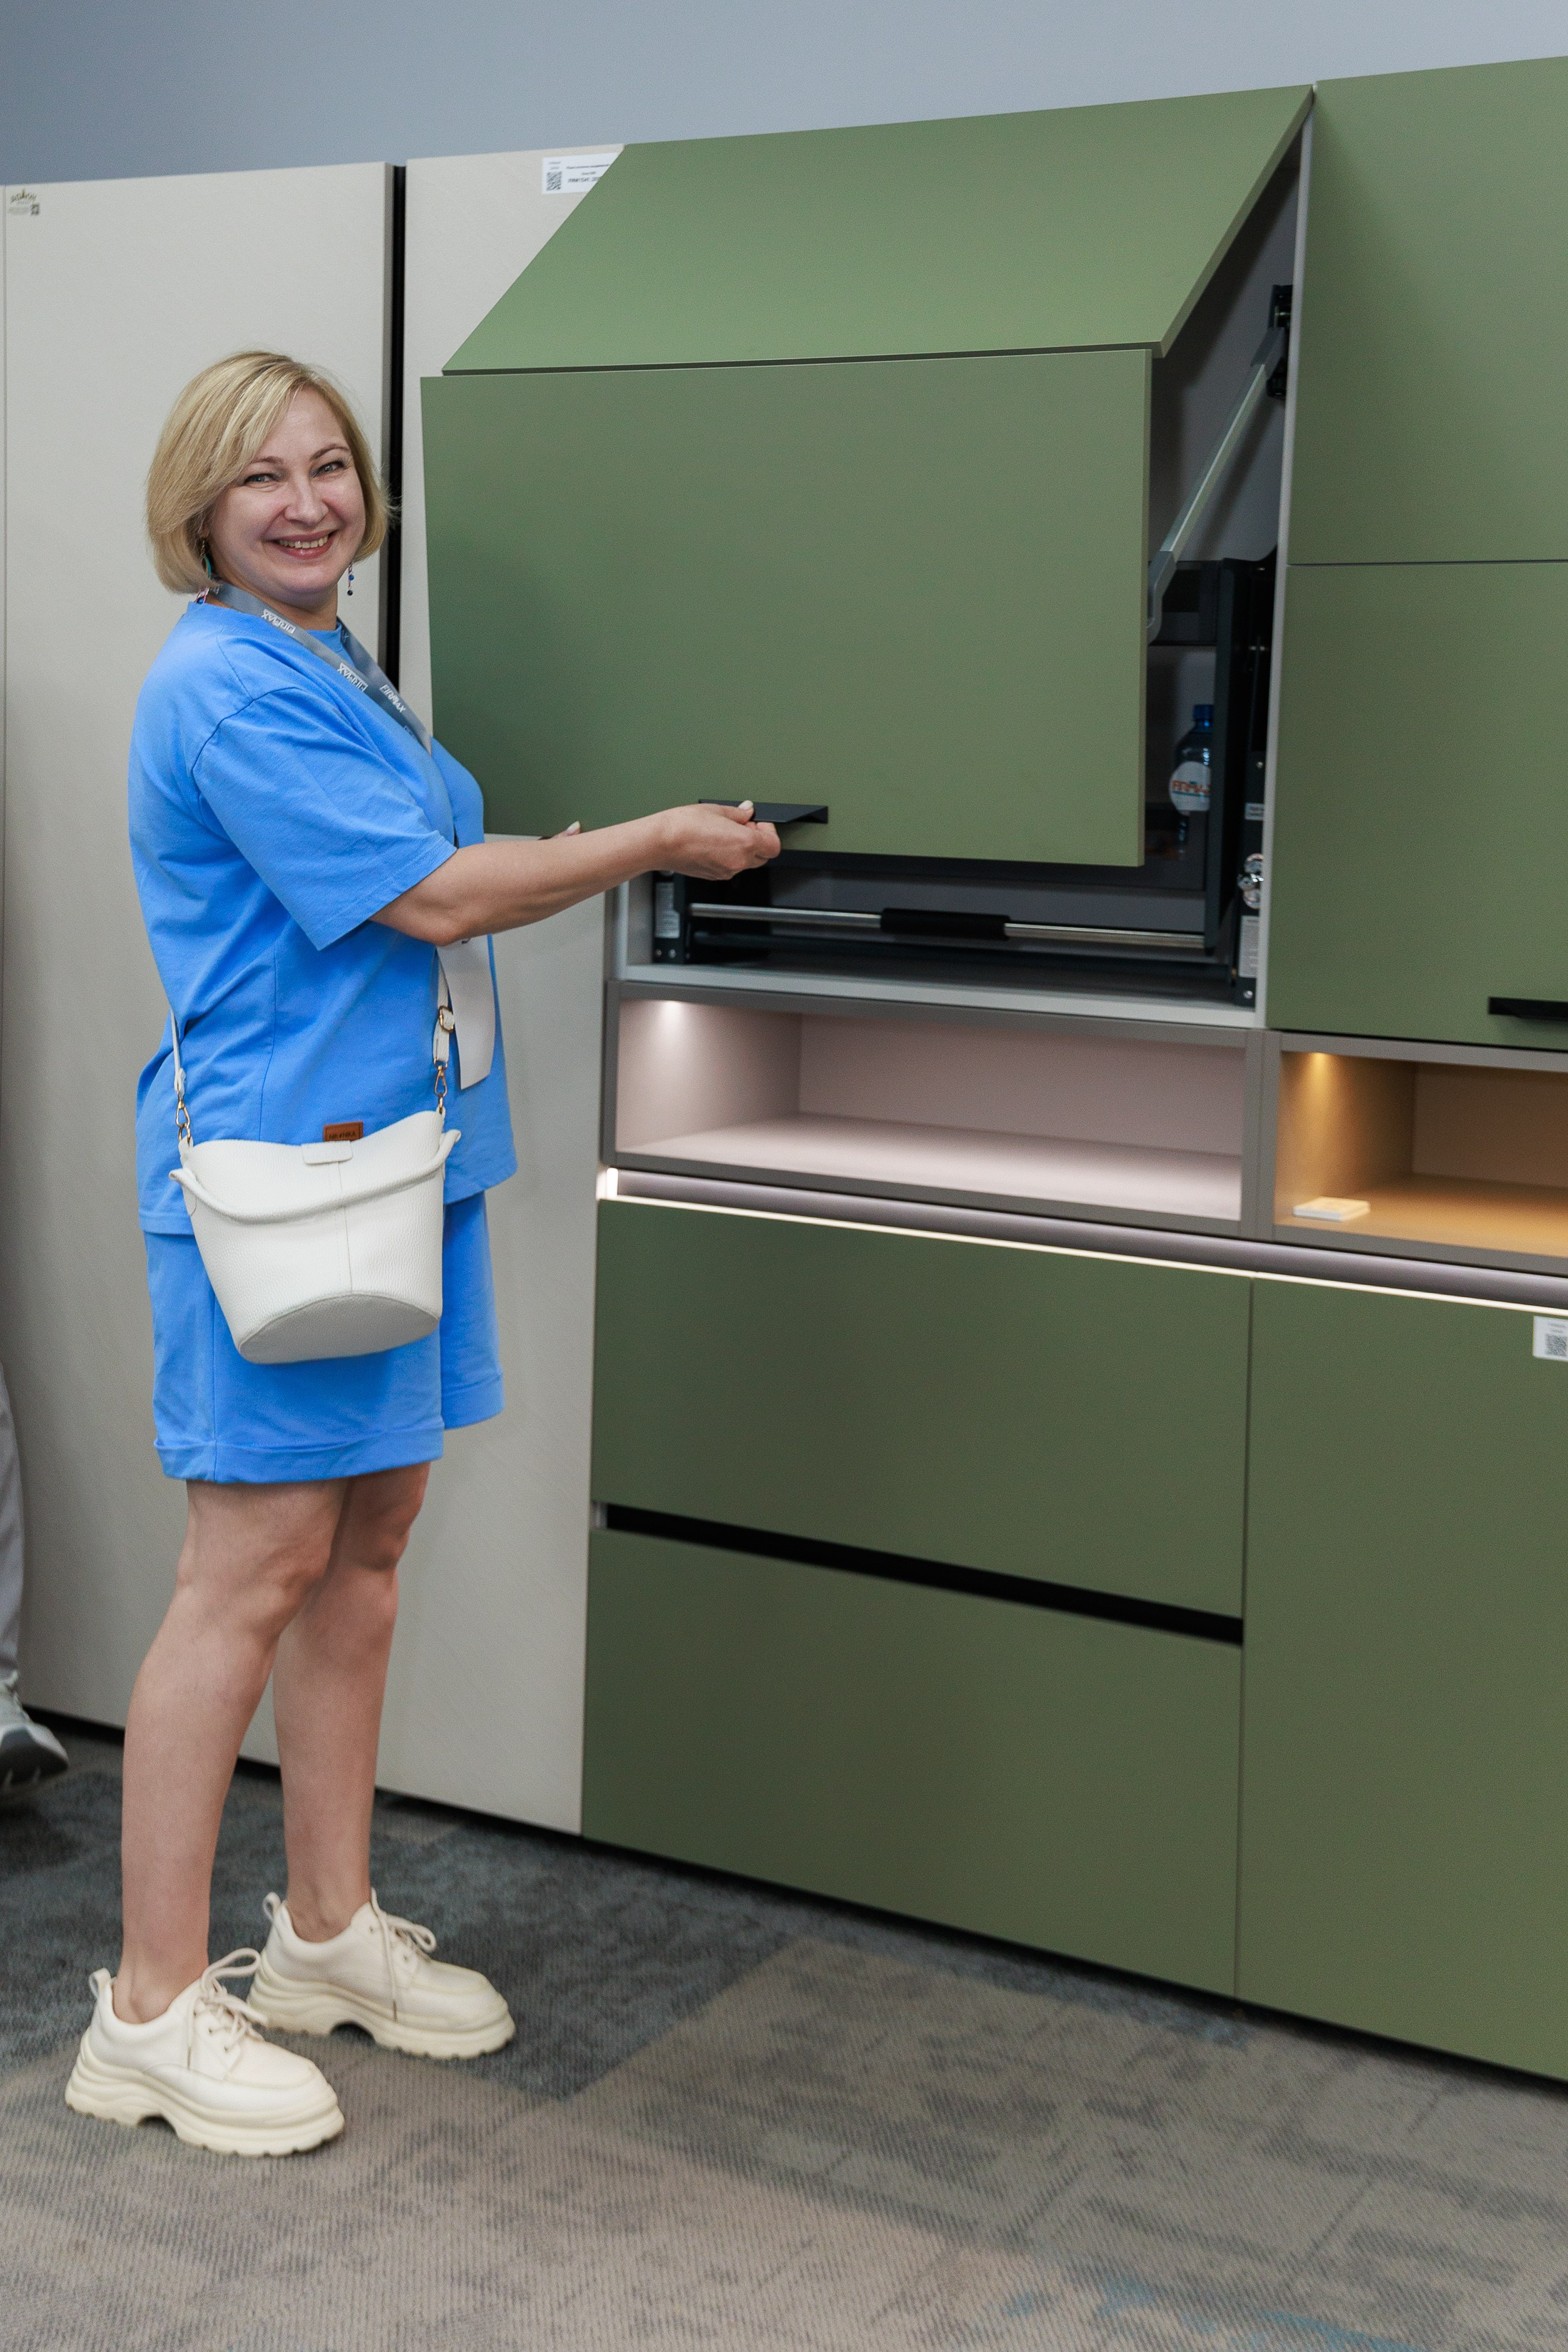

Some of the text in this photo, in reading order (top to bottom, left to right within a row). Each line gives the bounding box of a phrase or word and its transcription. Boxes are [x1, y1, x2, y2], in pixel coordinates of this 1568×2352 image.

[261, 609, 296, 634] FIRMAX
[337, 662, 368, 692] FIRMAX
[379, 684, 406, 713] FIRMAX
